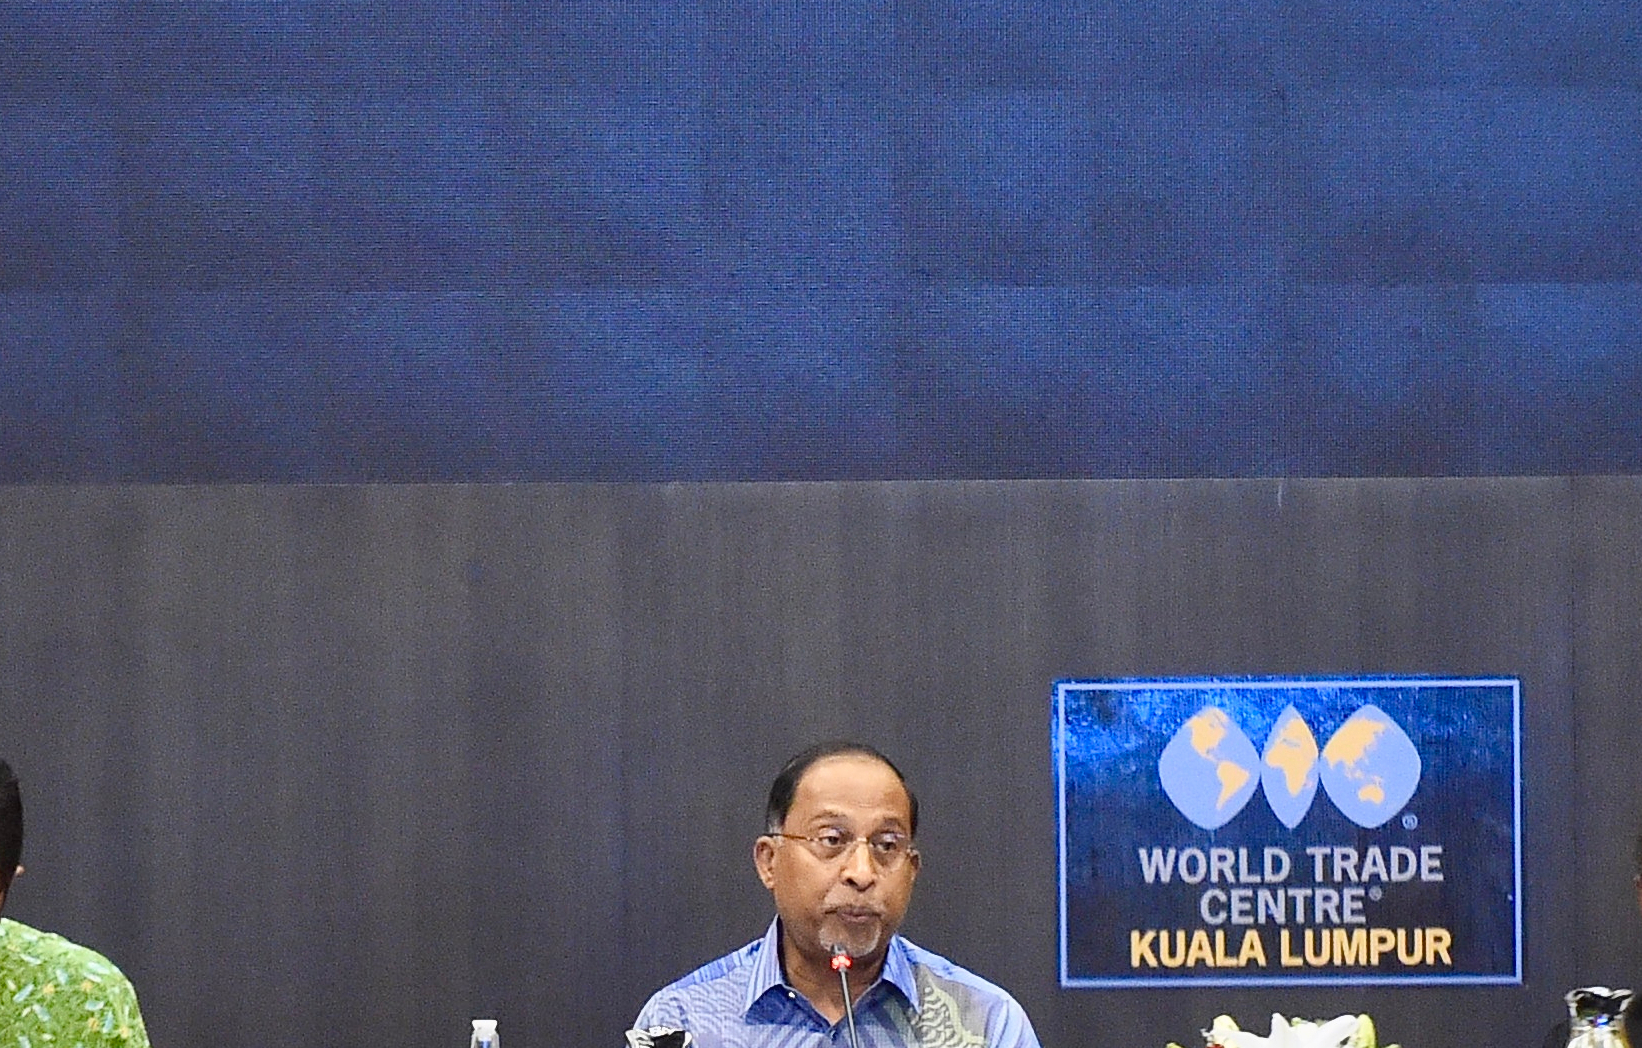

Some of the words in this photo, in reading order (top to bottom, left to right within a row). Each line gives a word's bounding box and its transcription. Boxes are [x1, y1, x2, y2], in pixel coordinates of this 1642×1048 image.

[1138, 846, 1292, 884] WORLD
[1306, 844, 1445, 883] TRADE
[1130, 928, 1267, 968] KUALA
[1280, 927, 1453, 968] LUMPUR
